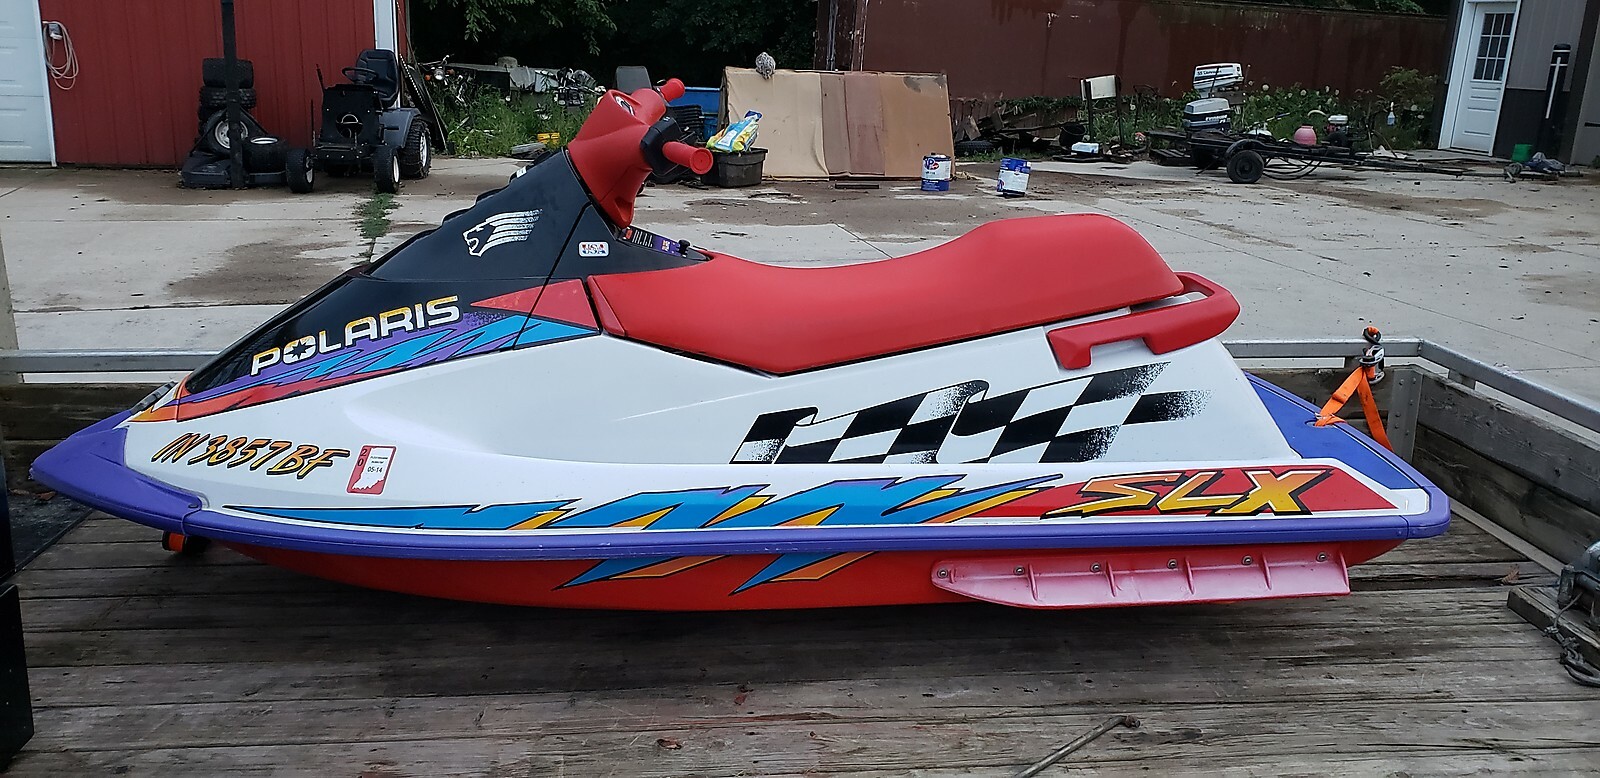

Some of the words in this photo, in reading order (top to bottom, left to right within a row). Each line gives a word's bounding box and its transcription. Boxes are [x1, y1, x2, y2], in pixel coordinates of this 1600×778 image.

[250, 295, 460, 376] POLARIS
[151, 432, 211, 463] IN
[188, 434, 292, 471] 3857
[266, 443, 351, 480] BF
[1040, 468, 1334, 519] SLX
